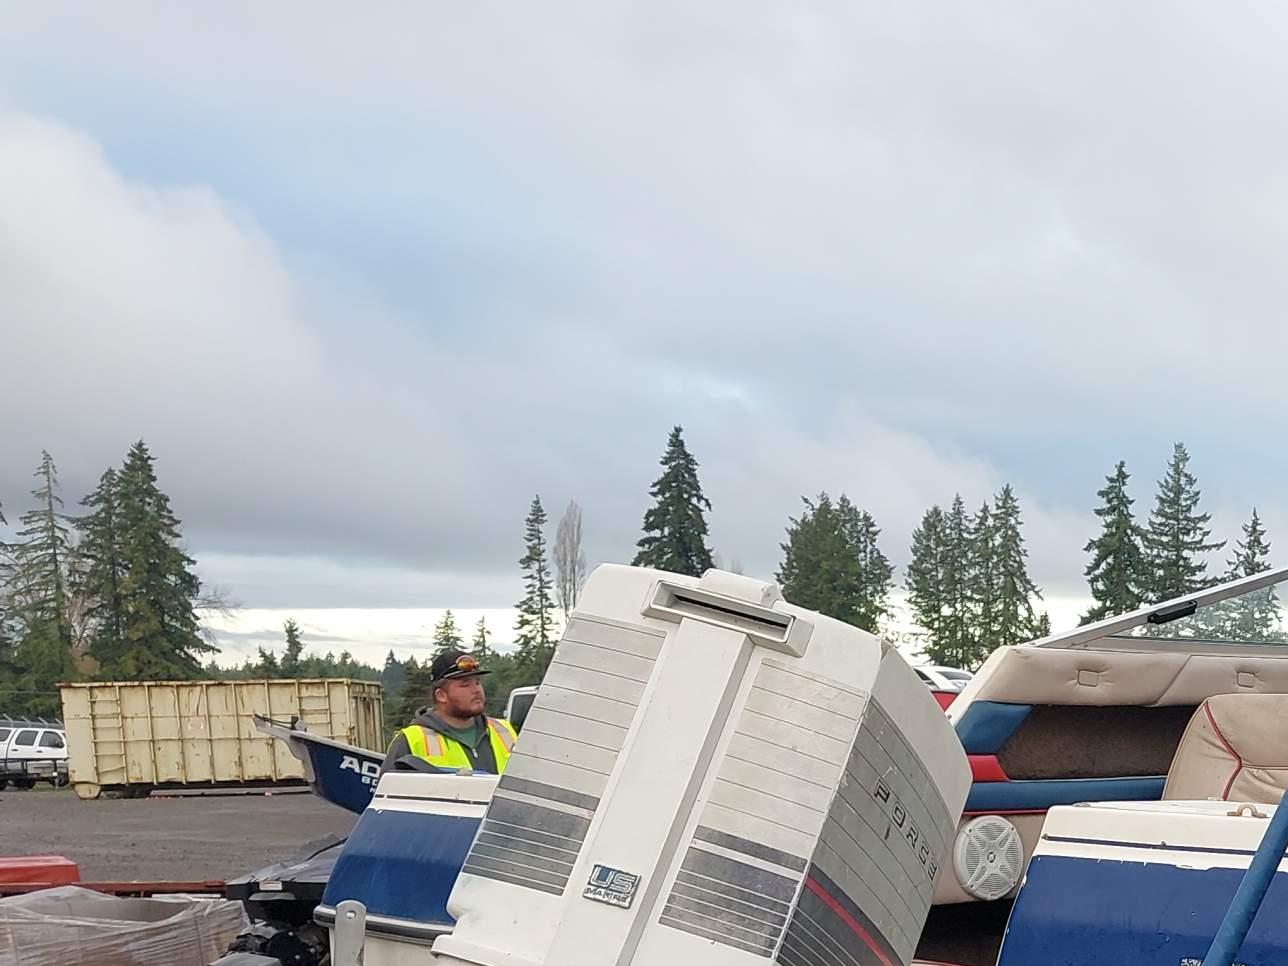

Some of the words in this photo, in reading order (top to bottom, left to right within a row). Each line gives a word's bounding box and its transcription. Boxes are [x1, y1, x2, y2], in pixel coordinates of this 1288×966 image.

[339, 755, 381, 778] AD
[874, 779, 938, 881] FORCE
[590, 866, 637, 895] US
